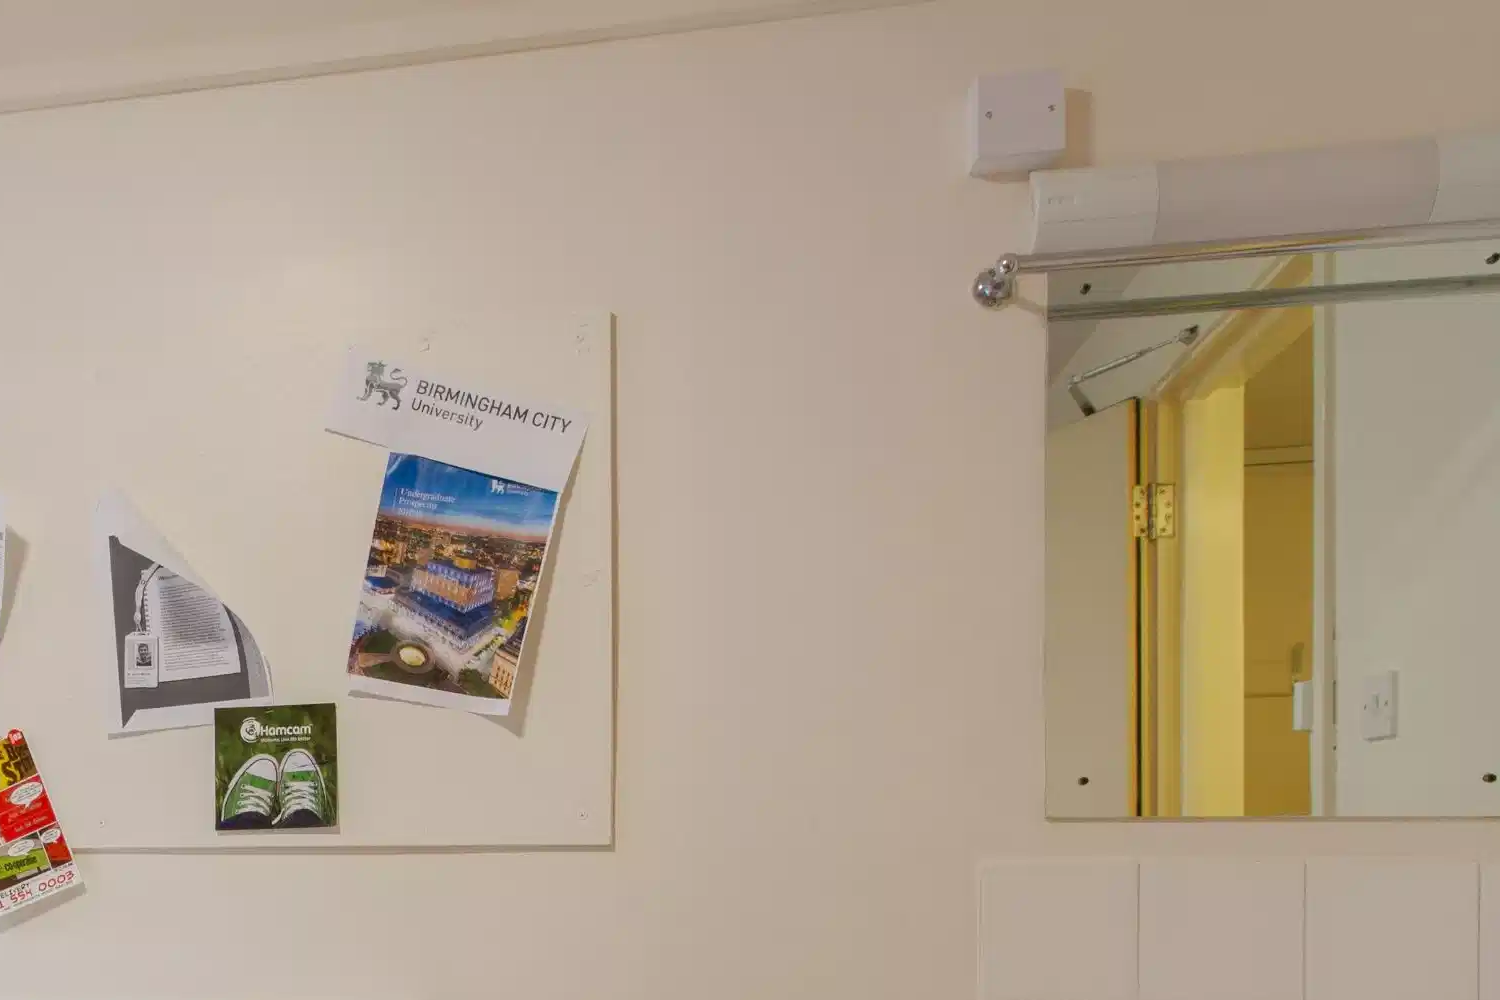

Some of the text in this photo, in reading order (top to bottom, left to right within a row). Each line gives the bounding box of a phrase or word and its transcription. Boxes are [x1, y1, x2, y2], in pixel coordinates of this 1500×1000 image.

[410, 397, 484, 432] University
[415, 379, 573, 434] BIRMINGHAM CITY
[260, 724, 312, 737] Hamcam
